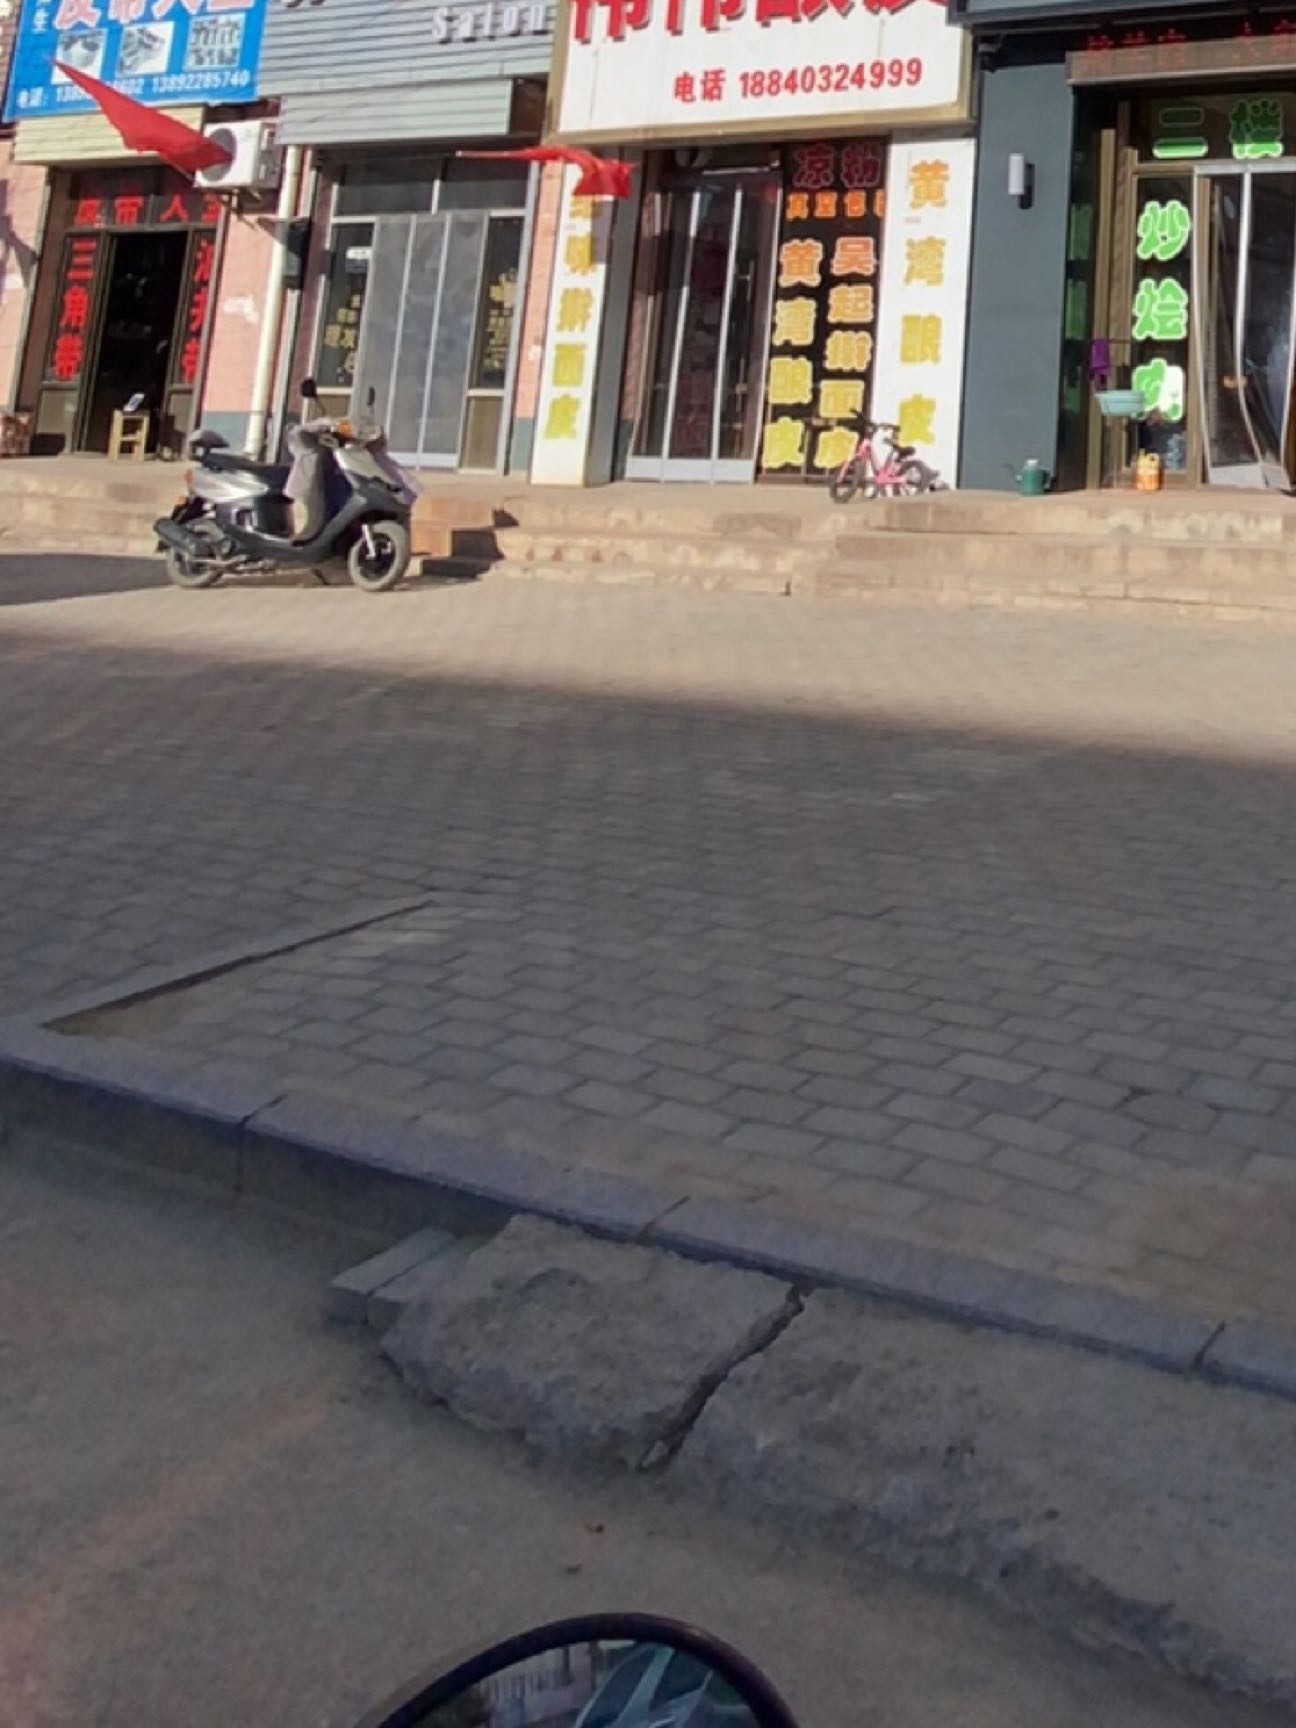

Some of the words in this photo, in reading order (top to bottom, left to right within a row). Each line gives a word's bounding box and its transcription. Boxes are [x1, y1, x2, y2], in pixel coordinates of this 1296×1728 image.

[673, 67, 726, 103] 电话
[738, 57, 923, 99] 18840324999
[54, 239, 97, 383] 三角带
